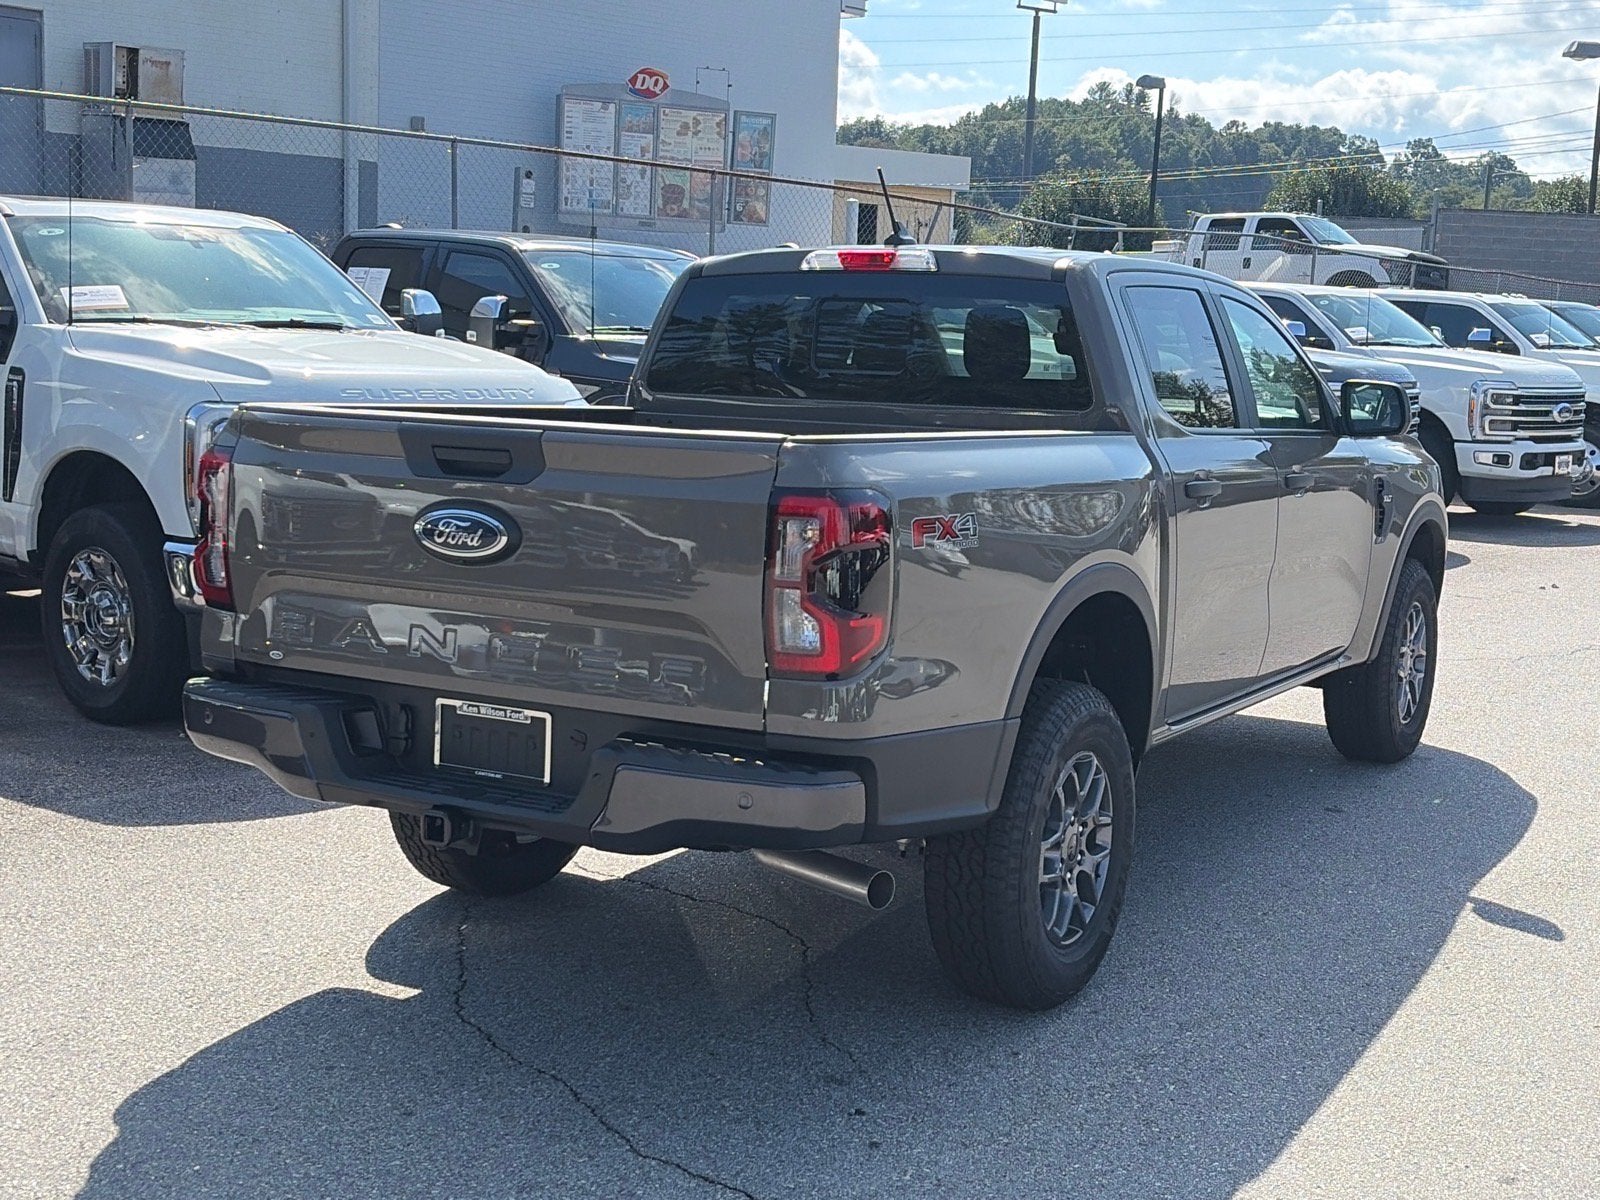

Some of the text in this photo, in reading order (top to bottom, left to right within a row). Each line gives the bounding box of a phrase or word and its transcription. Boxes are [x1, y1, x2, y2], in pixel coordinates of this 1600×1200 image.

[634, 73, 664, 94] DQ
[340, 387, 536, 401] SUPER DUTY
[433, 518, 484, 547] Ford
[911, 512, 979, 550] FX4
[462, 704, 525, 720] Ken Wilson Ford
